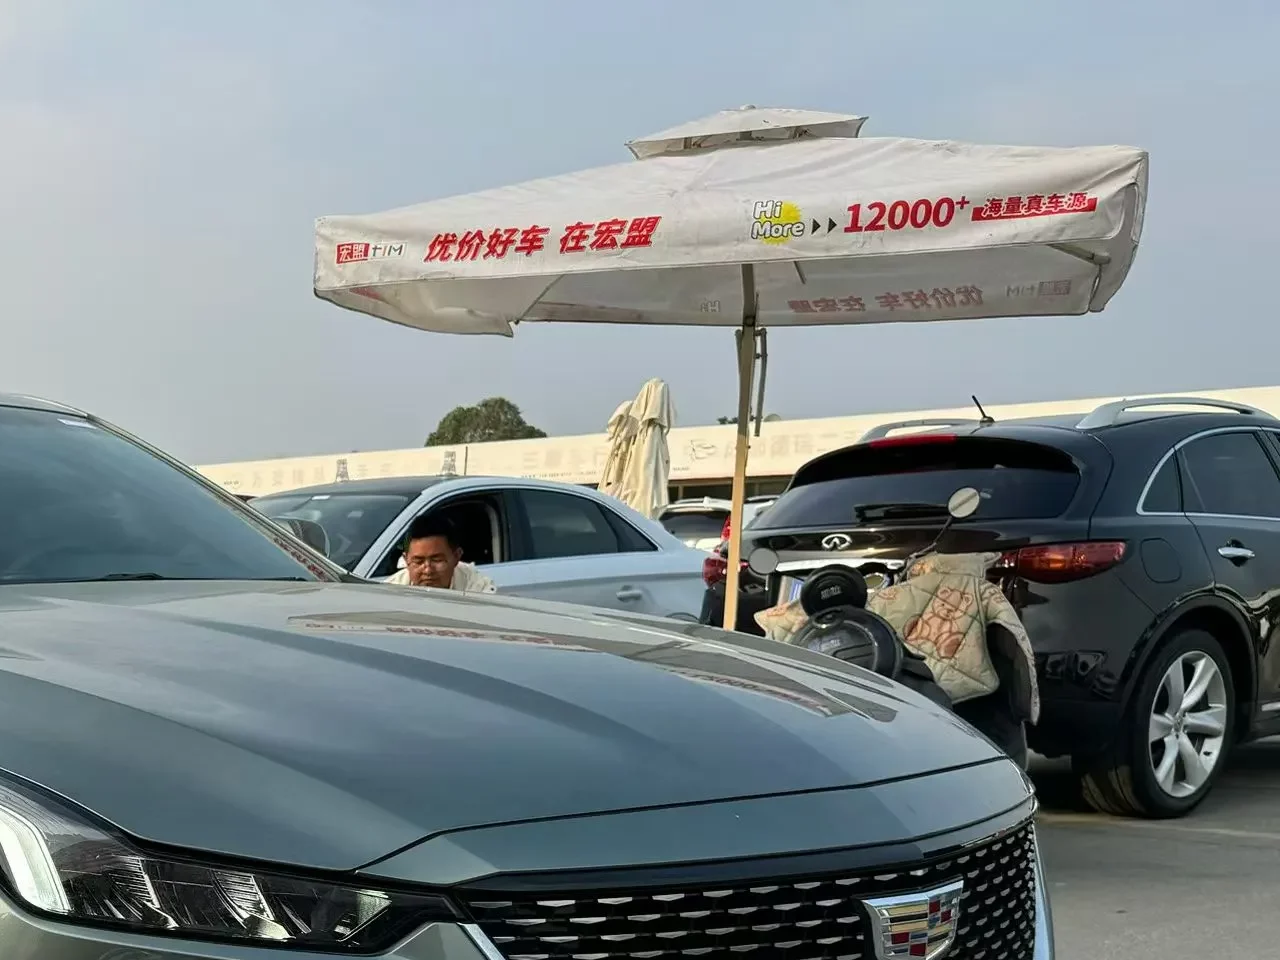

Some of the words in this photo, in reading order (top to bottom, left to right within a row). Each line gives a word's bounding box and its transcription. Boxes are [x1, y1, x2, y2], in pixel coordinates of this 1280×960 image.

[752, 201, 782, 220] Hi
[982, 192, 1089, 217] 海量真车源
[423, 224, 550, 262] 优价好车
[559, 216, 662, 254] 在宏盟
[750, 221, 805, 239] More
[338, 243, 365, 262] 宏盟
